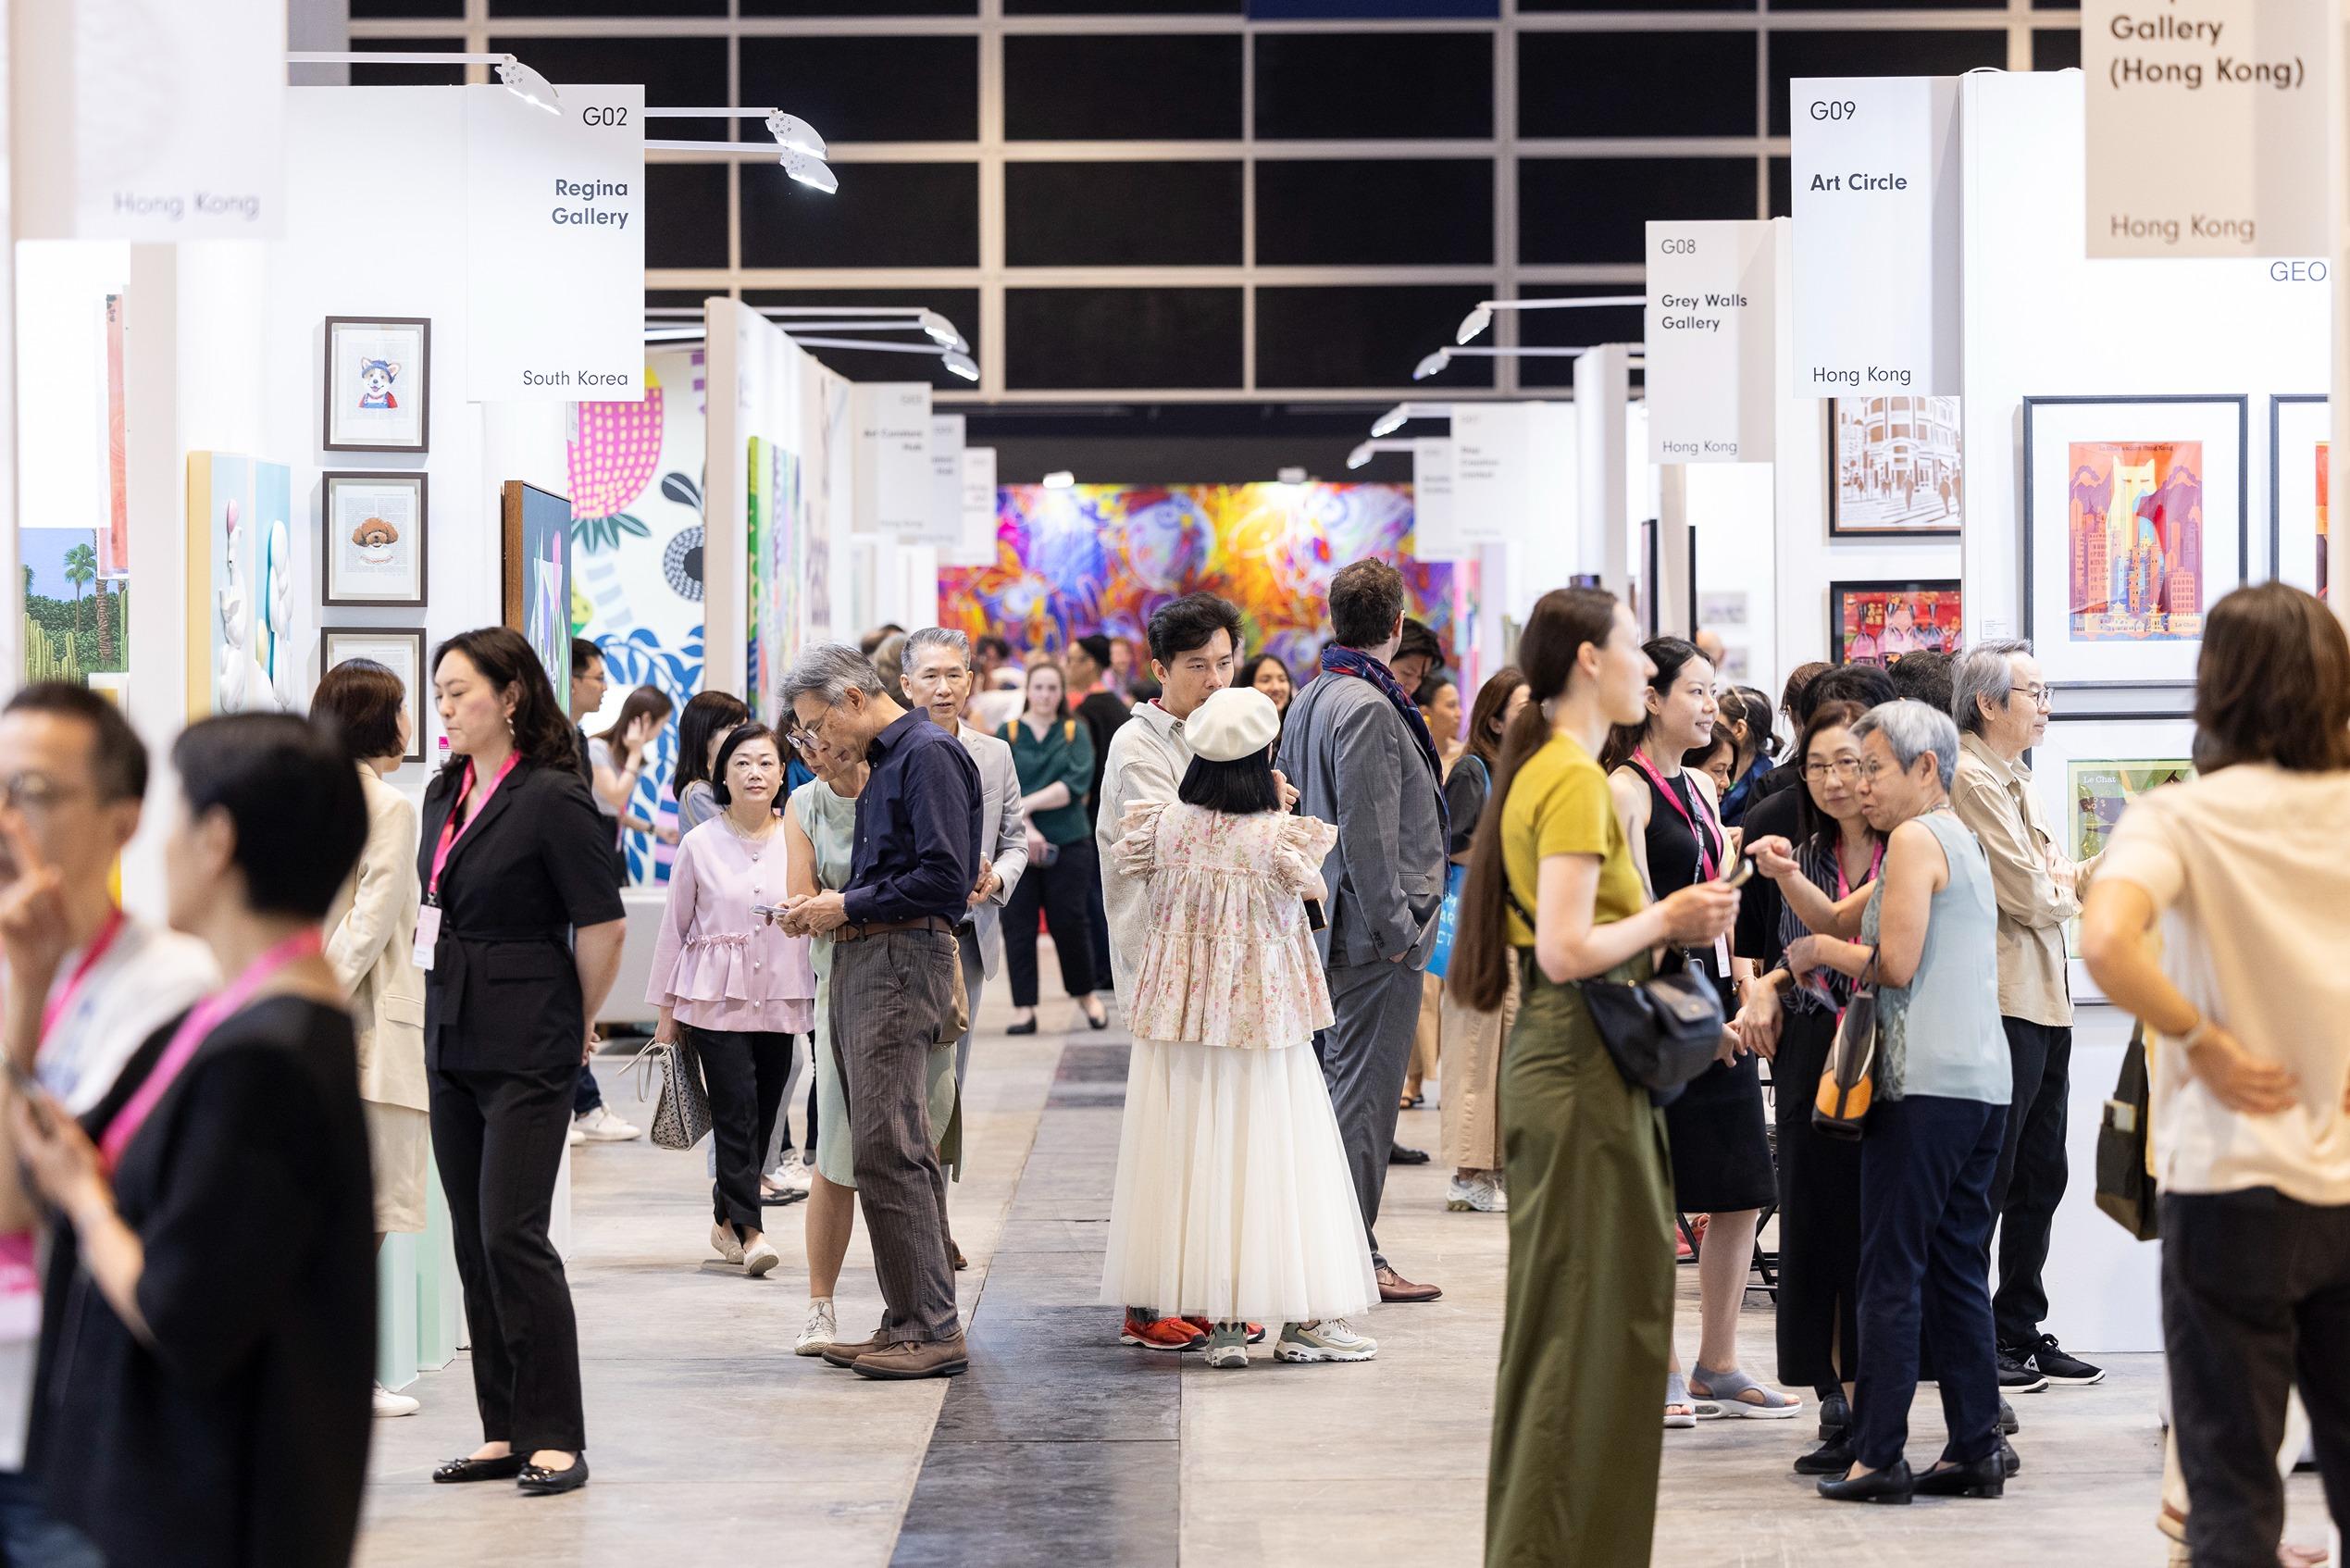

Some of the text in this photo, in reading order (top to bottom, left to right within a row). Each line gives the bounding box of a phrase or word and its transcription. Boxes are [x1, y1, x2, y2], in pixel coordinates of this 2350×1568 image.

[2110, 14, 2223, 45] Gallery
[2110, 57, 2305, 89] (Hong Kong)
[582, 106, 628, 126] G02
[1810, 101, 1856, 120] G09
[555, 179, 628, 202] Regina
[1810, 173, 1908, 191] Art Circle
[112, 190, 260, 221] Hong Kong
[552, 206, 628, 230] Gallery
[2110, 215, 2256, 244] Hong Kong
[1660, 238, 1696, 255] G08
[1661, 293, 1747, 311] Grey Walls
[1661, 316, 1721, 332] Gallery
[523, 370, 628, 386] South Korea
[1813, 367, 1911, 387] Hong Kong
[1662, 441, 1737, 456] Hong Kong
[2083, 776, 2094, 784] Le
